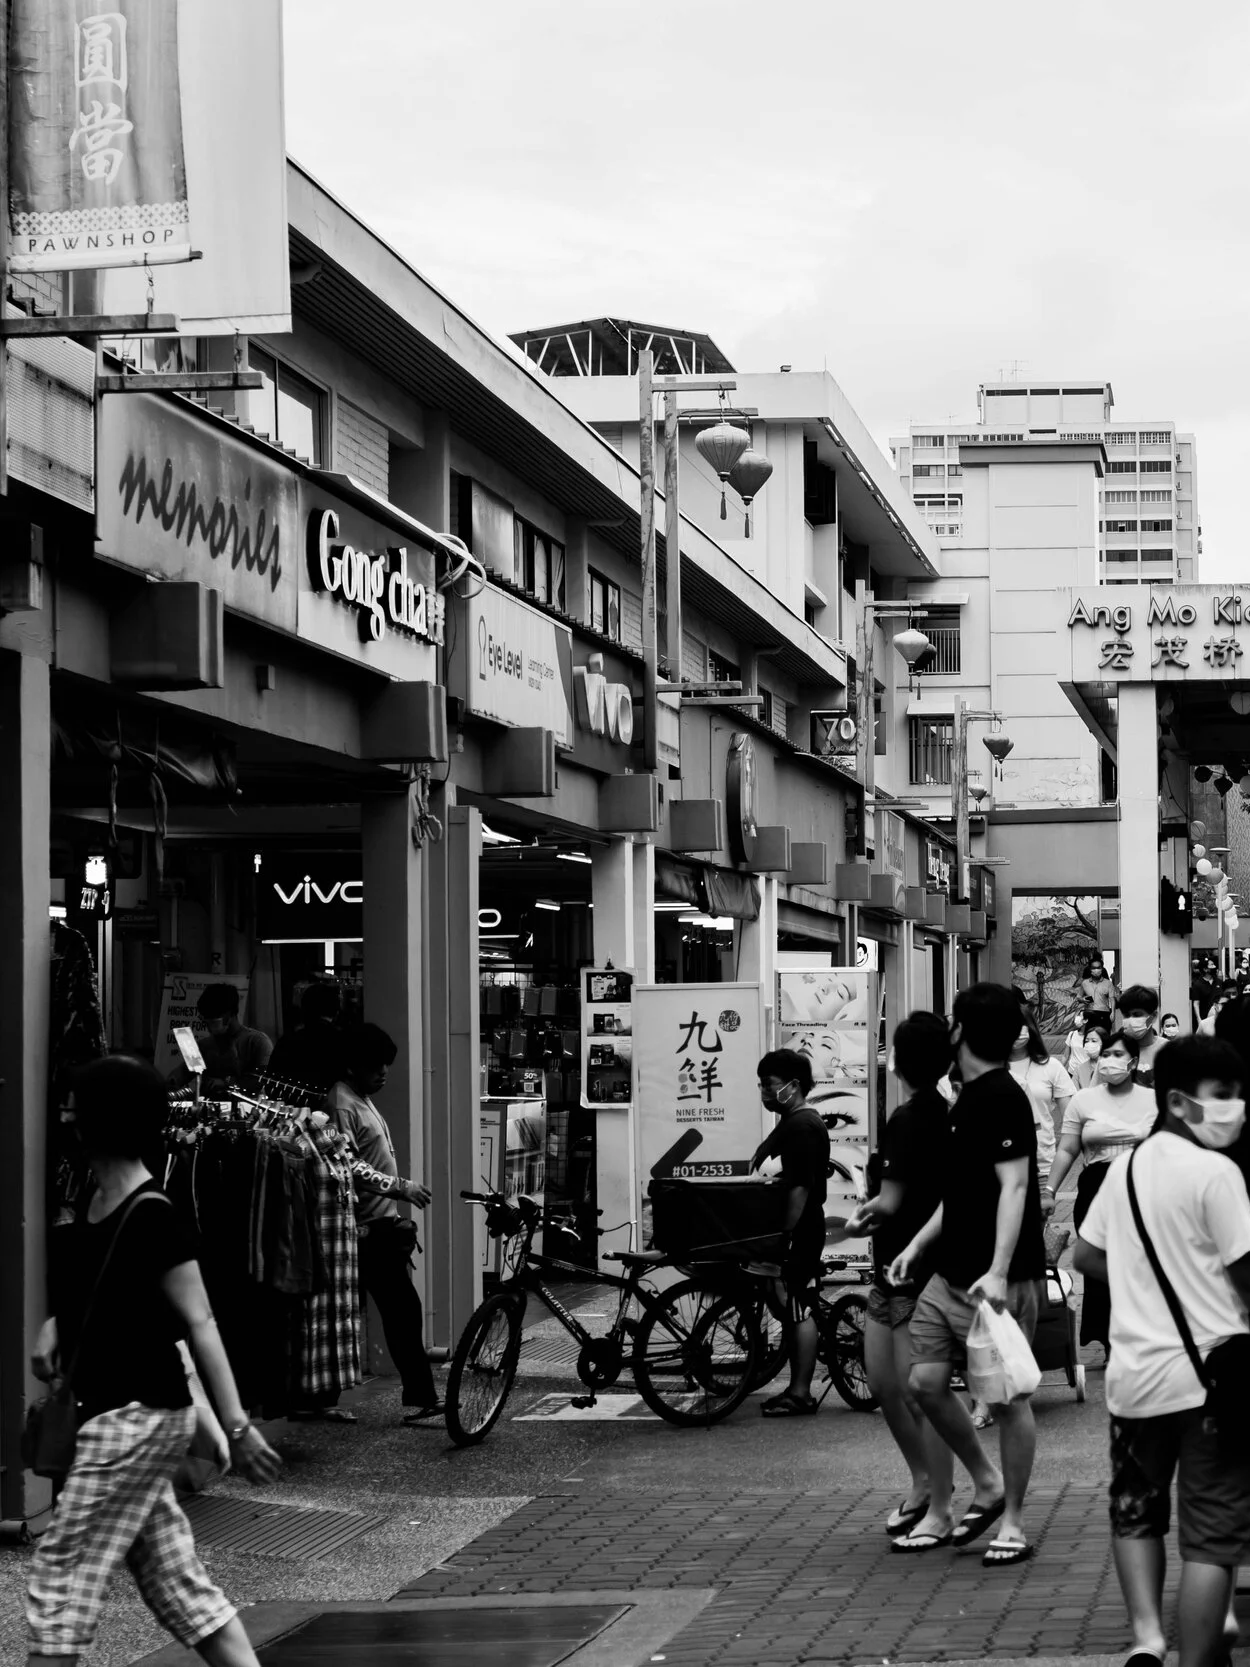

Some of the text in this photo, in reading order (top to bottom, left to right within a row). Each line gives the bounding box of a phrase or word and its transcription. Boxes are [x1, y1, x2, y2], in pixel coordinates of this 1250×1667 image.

[28, 229, 174, 252] PAWNSHOP
[119, 454, 282, 593] memories
[319, 509, 385, 642] Gong
[388, 547, 428, 636] cha
[1067, 597, 1132, 633] Ang
[1147, 596, 1197, 626] Mo
[489, 634, 522, 681] Eye Level
[167, 1006, 198, 1017] HIGHEST
[675, 1010, 723, 1103] 九鲜
[676, 1107, 725, 1117] NINE FRESH
[672, 1164, 733, 1177] #01-2533
